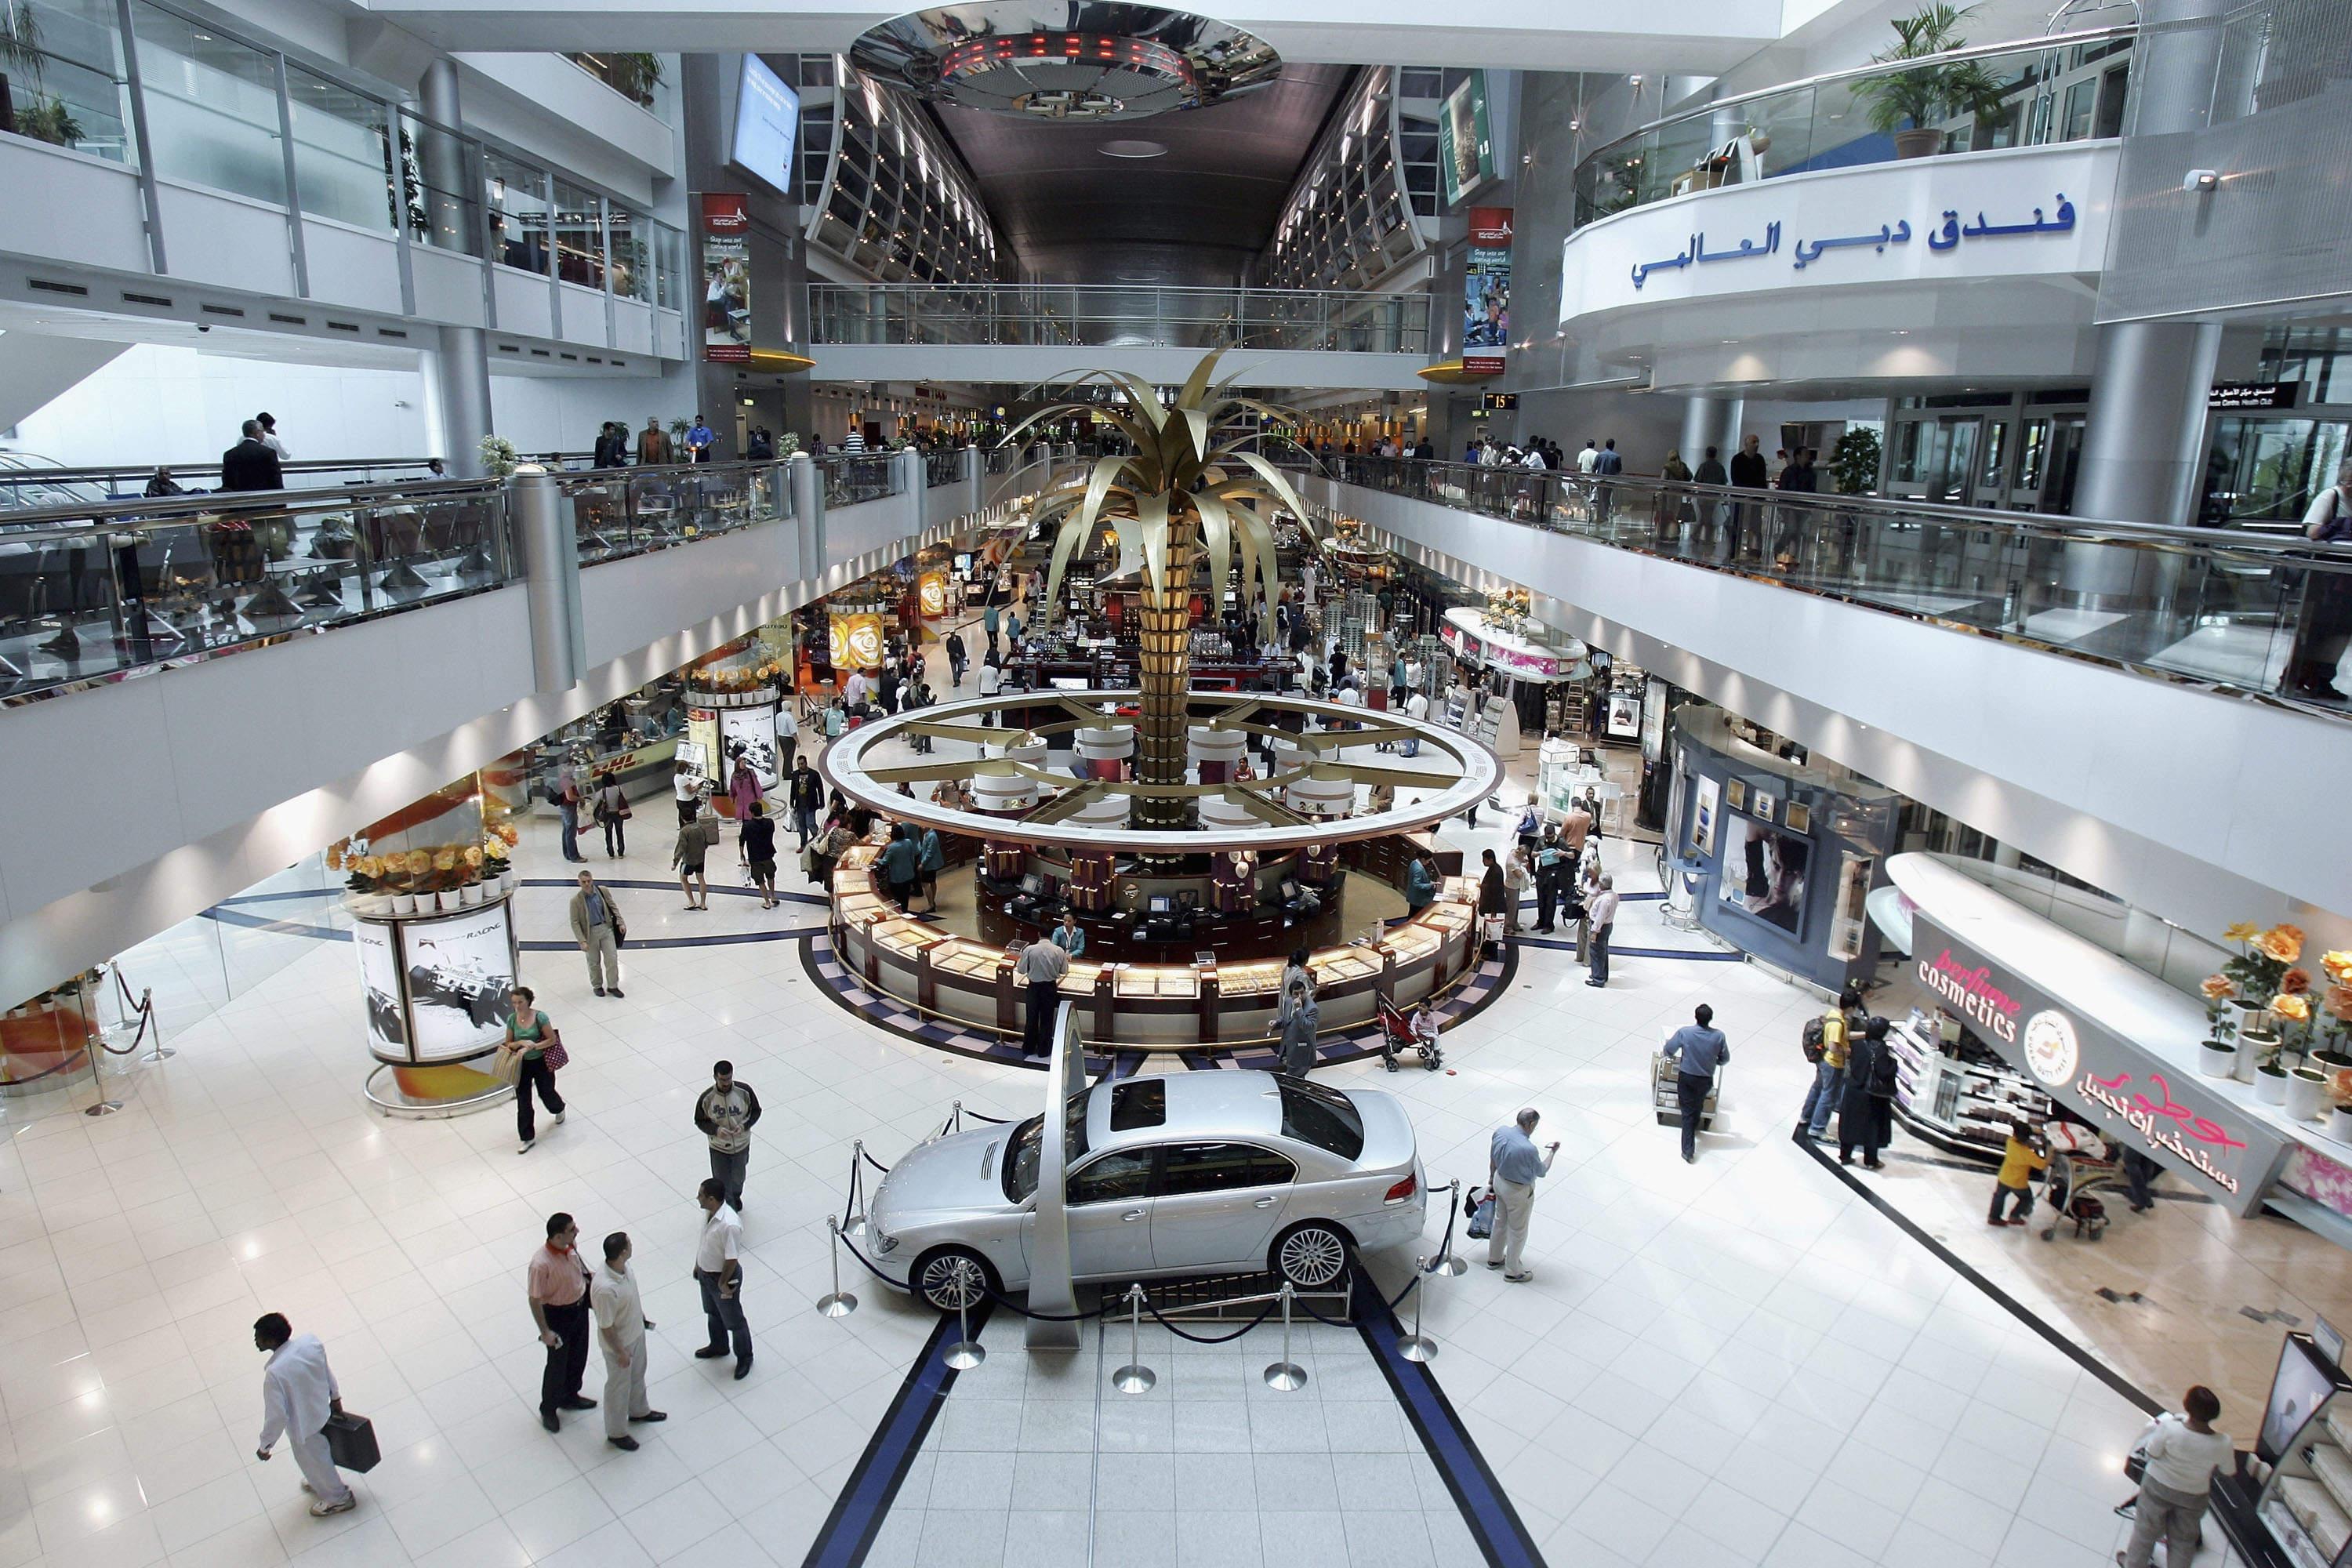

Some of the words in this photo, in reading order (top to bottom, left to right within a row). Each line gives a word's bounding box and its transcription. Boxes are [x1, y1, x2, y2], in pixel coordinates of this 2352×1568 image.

[1793, 219, 1911, 270] دبي
[1928, 192, 2077, 251] فندق
[1631, 220, 1781, 289] العالمي
[1496, 395, 1505, 408] 15
[591, 753, 637, 779] DHL
[1299, 801, 1326, 813] 22K
[466, 922, 502, 940] RACING
[1918, 960, 2017, 1043] cosmetics
[1934, 949, 2021, 1018] perfume
[2075, 1073, 2129, 1120] تجميل
